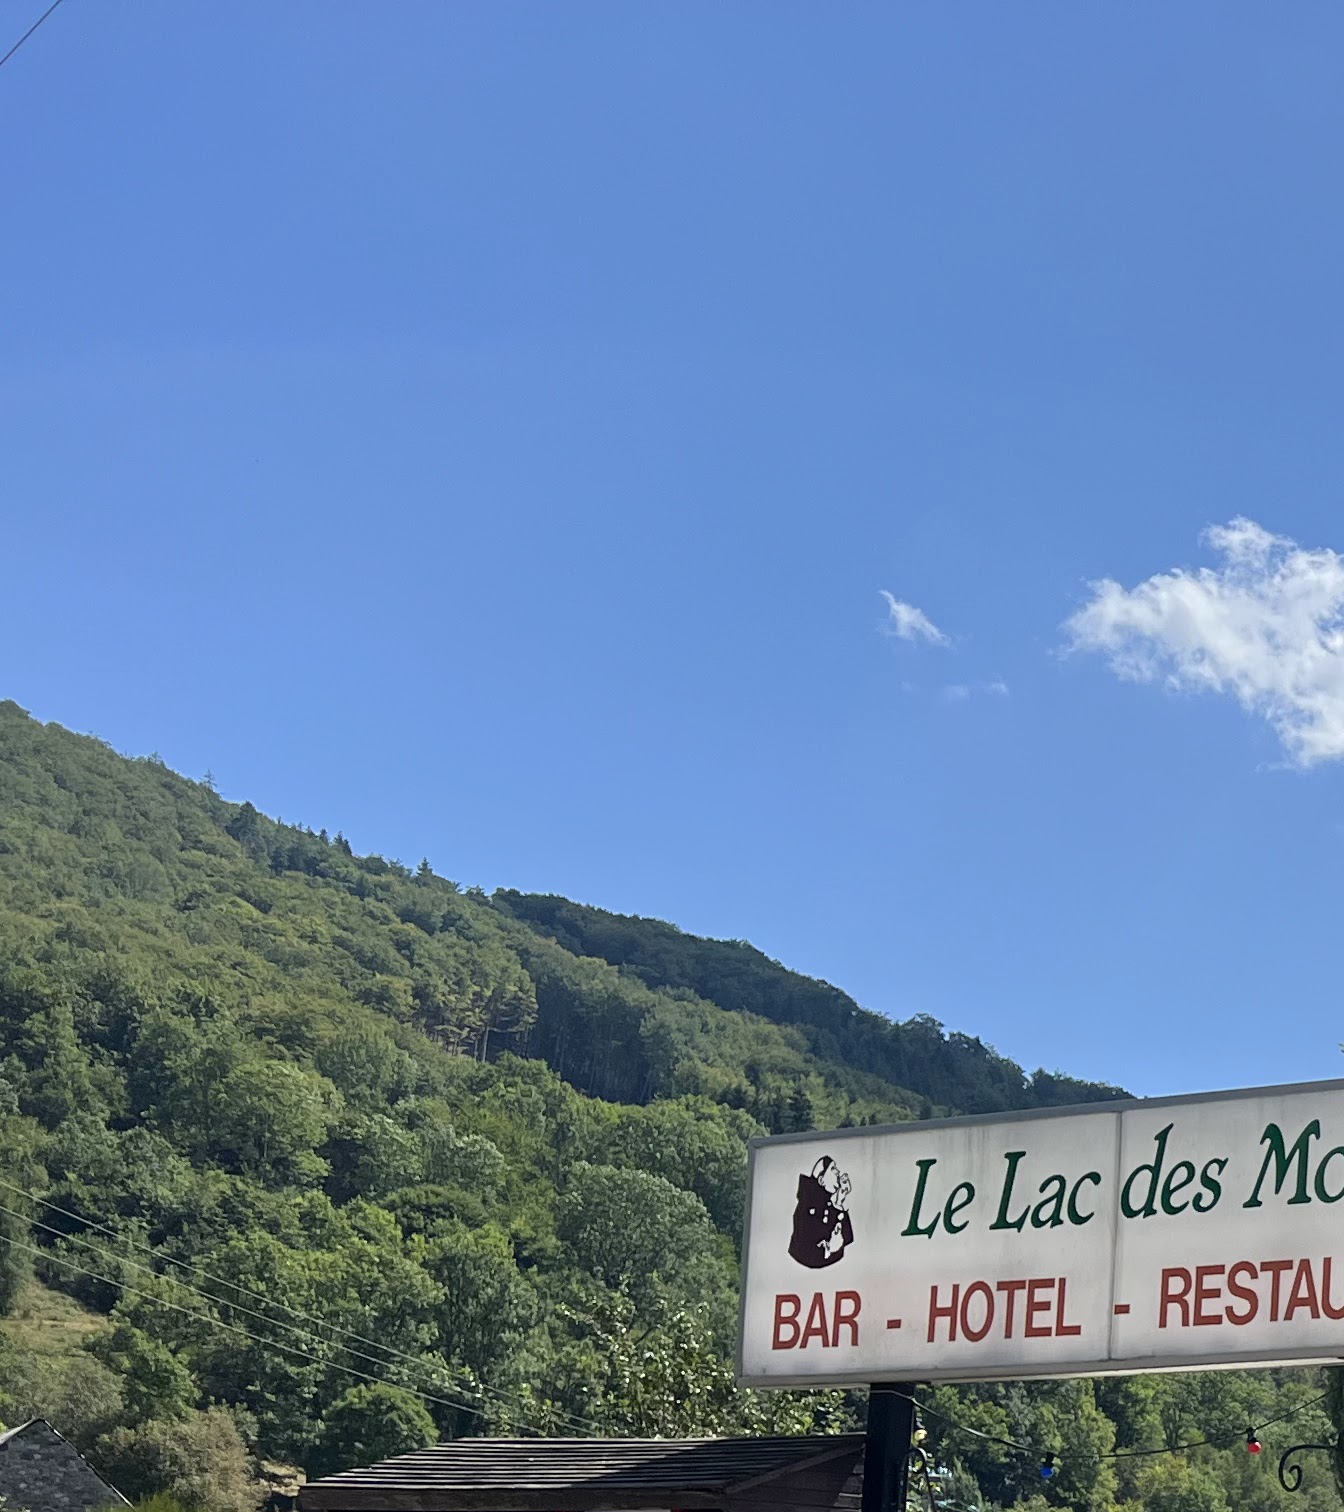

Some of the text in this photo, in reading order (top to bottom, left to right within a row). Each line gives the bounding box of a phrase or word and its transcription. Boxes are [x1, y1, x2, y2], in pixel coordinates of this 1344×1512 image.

[900, 1158, 975, 1238] Le
[989, 1151, 1101, 1234] Lac
[1121, 1123, 1229, 1219] des
[772, 1290, 860, 1351] BAR
[926, 1277, 1081, 1343] HOTEL
